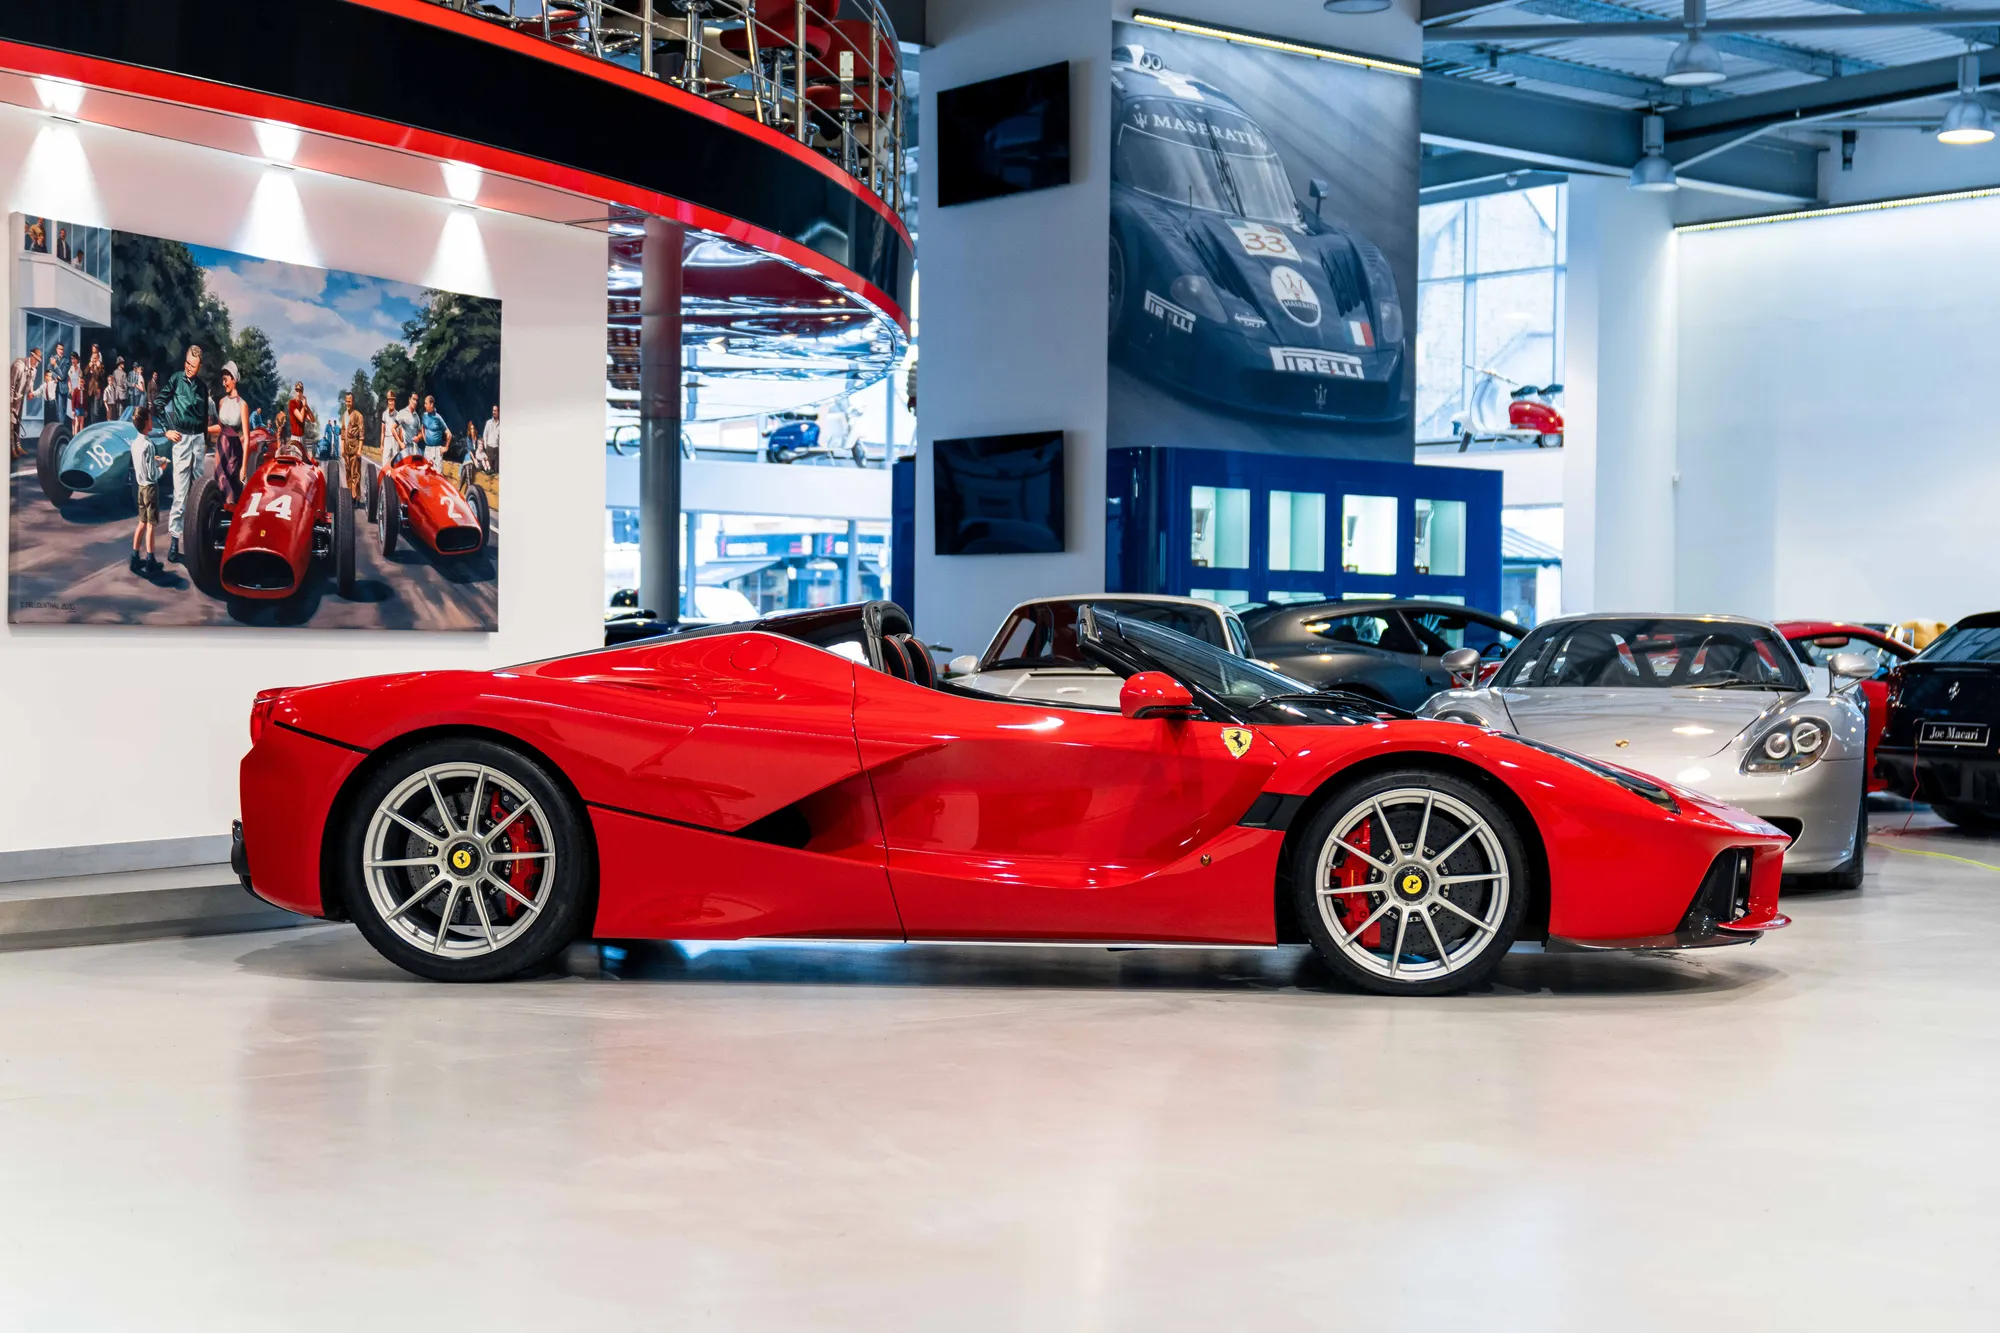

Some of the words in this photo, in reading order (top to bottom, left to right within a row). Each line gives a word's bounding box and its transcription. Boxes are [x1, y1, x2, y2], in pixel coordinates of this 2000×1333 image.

[1153, 113, 1256, 147] MASERATI
[1243, 232, 1287, 253] 33
[1144, 290, 1197, 333] PIRLLI
[1269, 346, 1365, 379] PIRELLI
[86, 444, 113, 469] 18
[241, 492, 292, 521] 14
[440, 496, 463, 519] 2
[1929, 726, 1945, 740] Joe
[1946, 726, 1979, 741] Macari
